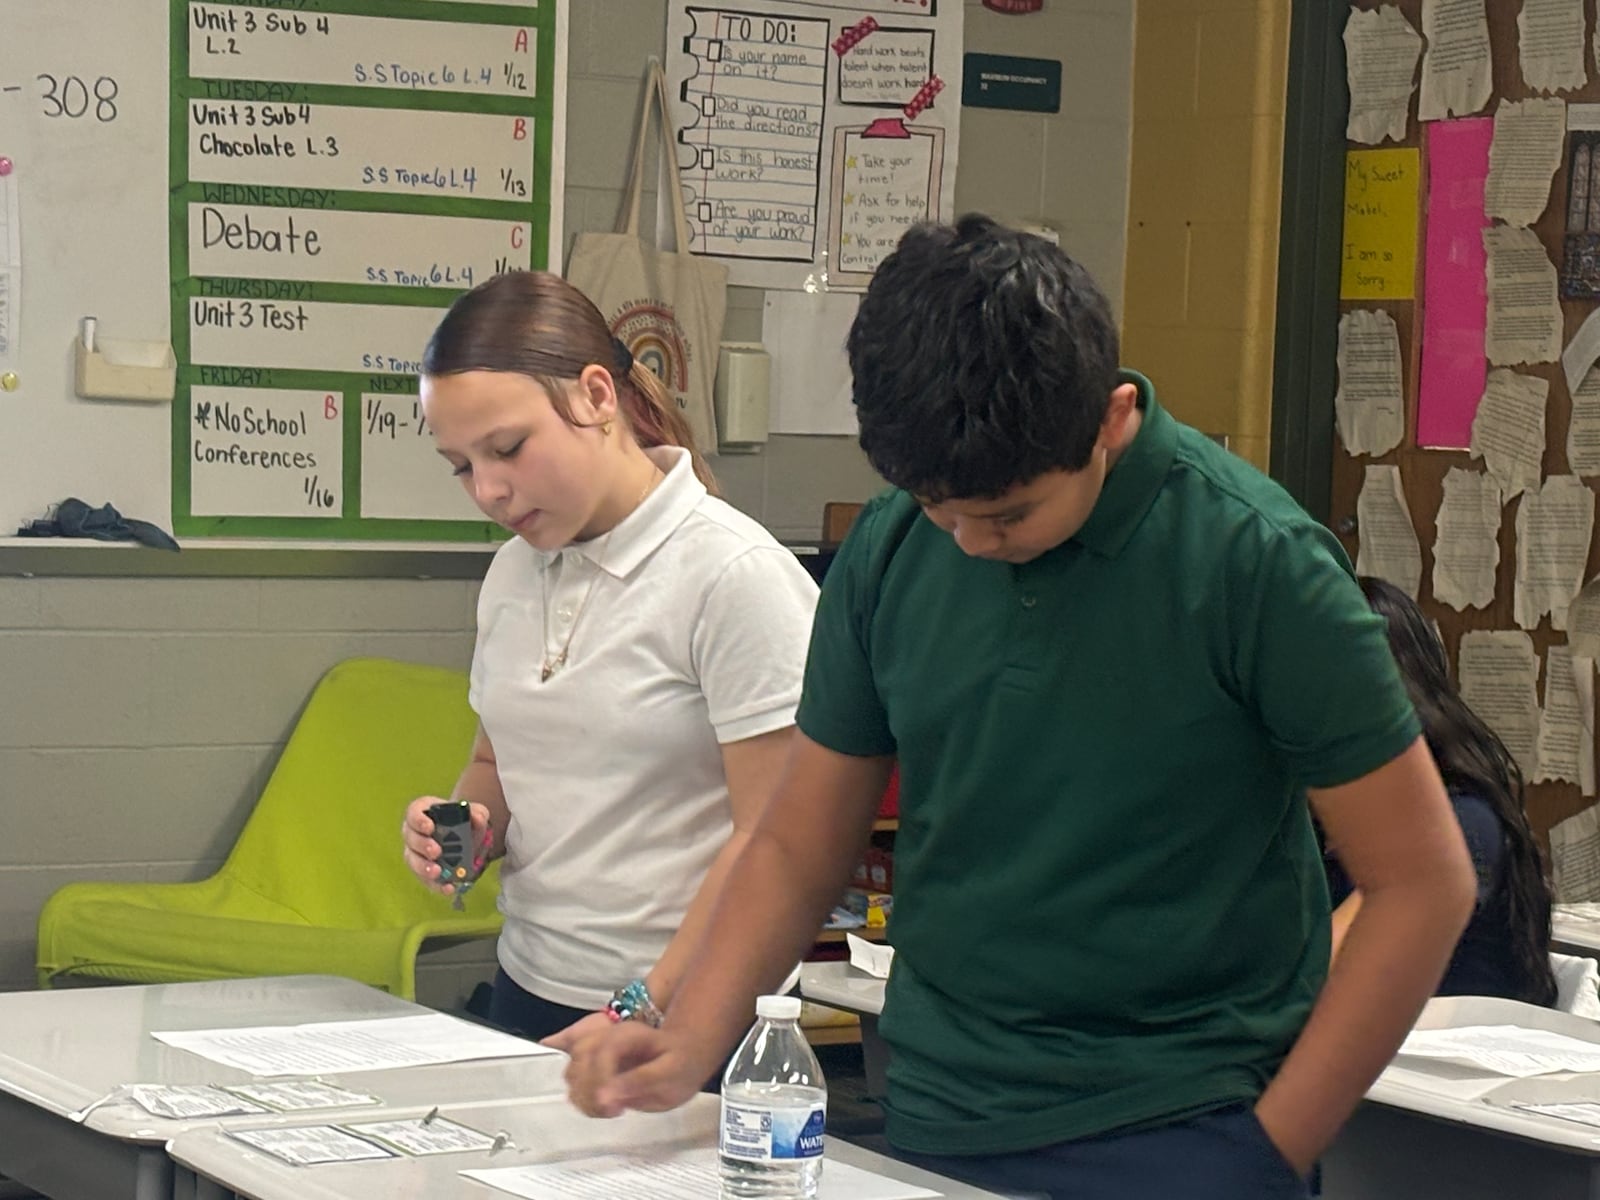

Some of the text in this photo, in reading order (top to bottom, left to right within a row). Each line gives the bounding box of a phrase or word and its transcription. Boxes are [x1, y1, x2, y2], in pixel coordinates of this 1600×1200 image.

[194, 6, 329, 35] Unit 3 Sub 4
[722, 15, 796, 44] TO DO:
[207, 36, 241, 55] L.2
[515, 29, 528, 53] A
[875, 48, 896, 57] work
[723, 45, 807, 66] Is your name
[872, 62, 896, 72] when
[391, 64, 438, 89] Topic
[504, 62, 527, 90] 1/12
[723, 64, 778, 80] on it?
[878, 79, 902, 88] work
[37, 73, 118, 121] 308
[202, 80, 309, 101] TUESDAY:
[193, 103, 310, 127] Unit 3 Sub 4
[717, 97, 807, 121] Did you read
[513, 118, 527, 140] B
[716, 115, 819, 137] the directions?
[200, 133, 339, 157] Chocolate L.3
[717, 147, 813, 170] Is this honest
[861, 153, 912, 170] Take your
[395, 169, 433, 187] Topic
[500, 168, 526, 196] 1/13
[716, 168, 764, 180] work?
[859, 173, 894, 184] time!
[203, 183, 336, 208] WEDNESDAY:
[860, 192, 925, 208] Ask for help
[715, 200, 811, 226] Are you proud
[850, 211, 859, 224] if
[866, 216, 885, 228] you
[203, 207, 321, 256] Debate
[511, 225, 523, 249] C
[713, 220, 805, 243] of your work?
[856, 234, 894, 248] You are
[1345, 243, 1354, 260] I
[1359, 251, 1376, 260] am
[394, 270, 430, 288] Topic
[430, 264, 441, 282] 6
[194, 300, 309, 331] Unit 3 Test
[370, 376, 417, 393] NEXT
[215, 402, 306, 436] No School
[324, 394, 338, 420] B
[367, 399, 395, 439] 1/19
[194, 440, 317, 469] Conferences
[304, 475, 334, 508] 1/16
